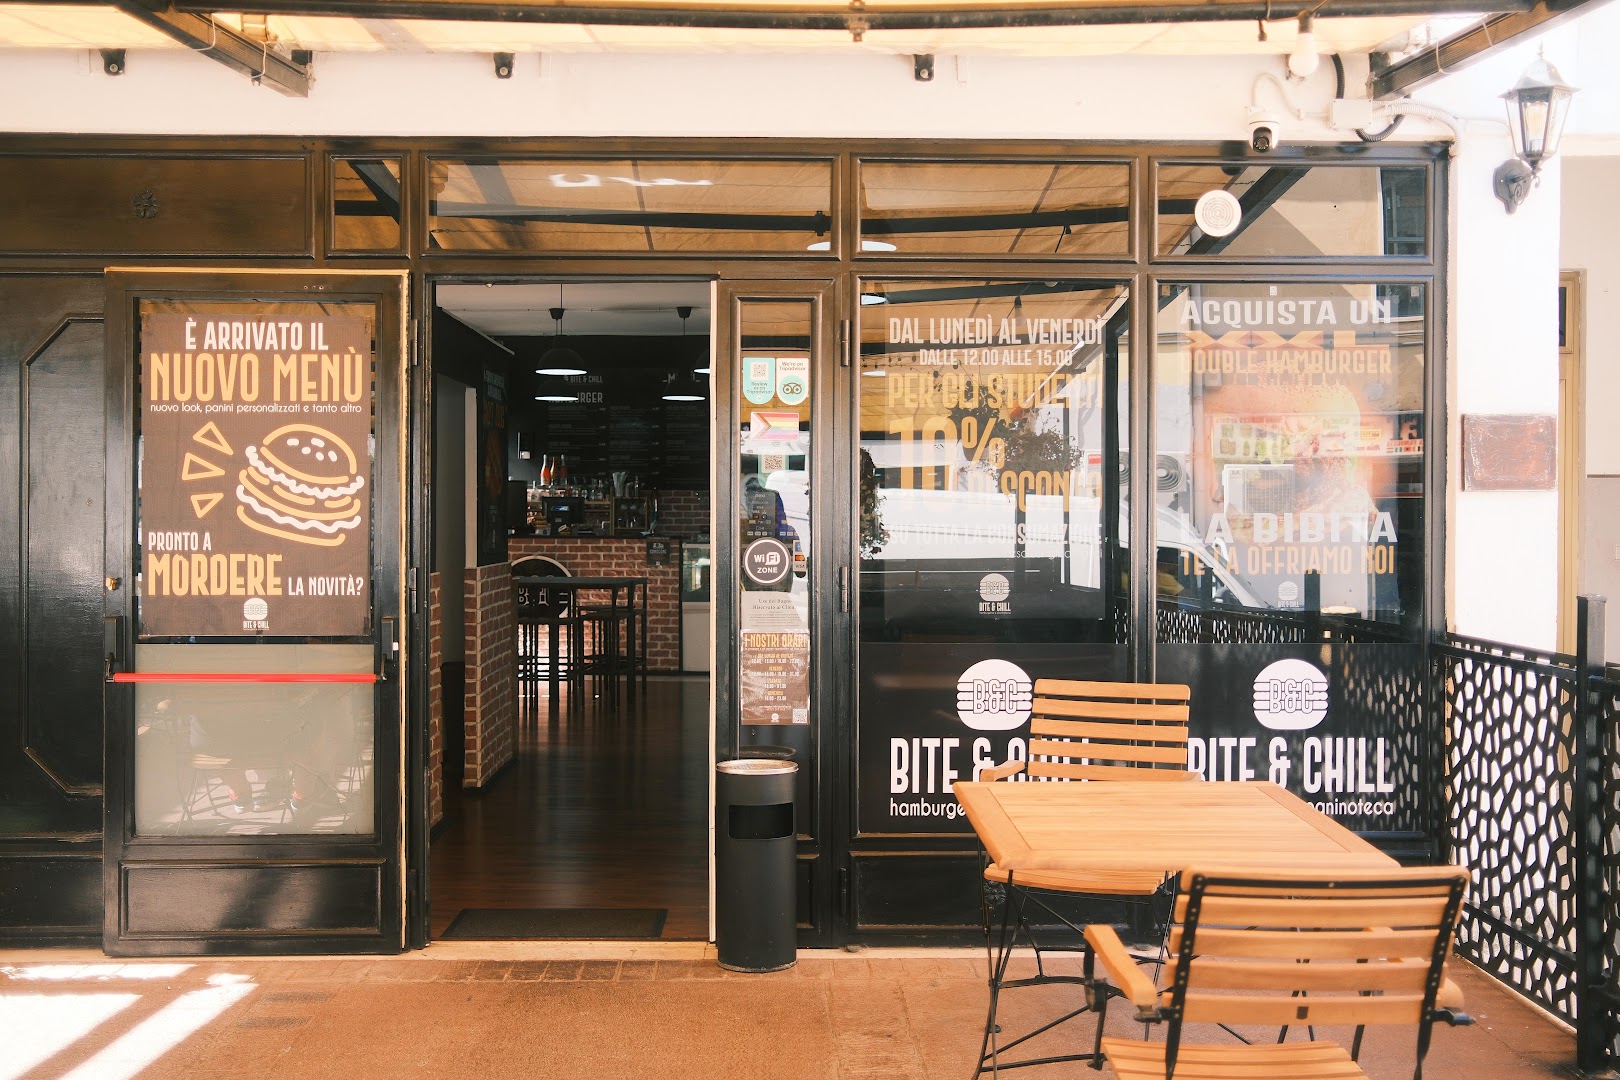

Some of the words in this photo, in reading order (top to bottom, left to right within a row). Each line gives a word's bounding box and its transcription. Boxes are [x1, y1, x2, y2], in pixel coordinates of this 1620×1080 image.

[889, 317, 924, 345] DAL
[929, 313, 992, 345] LUNEDÌ
[1000, 318, 1021, 345] AL
[1026, 314, 1103, 345] VENERDÌ
[1180, 299, 1337, 328] ACQUISTA
[1350, 299, 1391, 325] UN
[185, 317, 197, 350] È
[203, 321, 303, 351] ARRIVATO
[310, 322, 329, 351] IL
[1182, 330, 1390, 349] XXL
[919, 349, 958, 366] DALLE
[962, 349, 999, 366] 12.00
[1002, 349, 1032, 366] ALLE
[1036, 349, 1073, 366] 15.00
[1183, 350, 1259, 375] DOUBLE
[1265, 349, 1392, 374] HAMBURGER
[150, 352, 259, 402] NUOVO
[273, 346, 363, 402] MENÙ
[570, 375, 582, 383] BITE
[583, 375, 587, 383] &
[588, 375, 603, 383] CHILL
[888, 372, 934, 409] PER
[941, 372, 979, 409] GLI
[987, 372, 1103, 409] STUDENTI
[150, 404, 179, 412] nuovo
[181, 402, 203, 413] look,
[205, 403, 234, 414] panini
[236, 402, 301, 414] personalizzati
[303, 404, 309, 412] e
[312, 403, 338, 413] tanto
[340, 402, 362, 412] altro
[889, 415, 1006, 511] 10%
[148, 531, 199, 551] PRONTO
[203, 532, 212, 551] A
[1180, 512, 1235, 544] LA
[1253, 511, 1398, 544] BIBITA
[148, 553, 283, 596] MORDERE
[288, 576, 305, 596] LA
[308, 574, 364, 596] NOVITÀ?
[1181, 546, 1205, 576] TE
[1247, 545, 1352, 575] OFFRIAMO
[1360, 544, 1395, 575] NOI
[750, 634, 779, 648] NOSTRI
[972, 679, 1018, 714] B&C
[1269, 679, 1314, 714] B&C
[890, 737, 960, 794] BITE
[1268, 736, 1291, 790] &
[1303, 736, 1395, 794] CHILL
